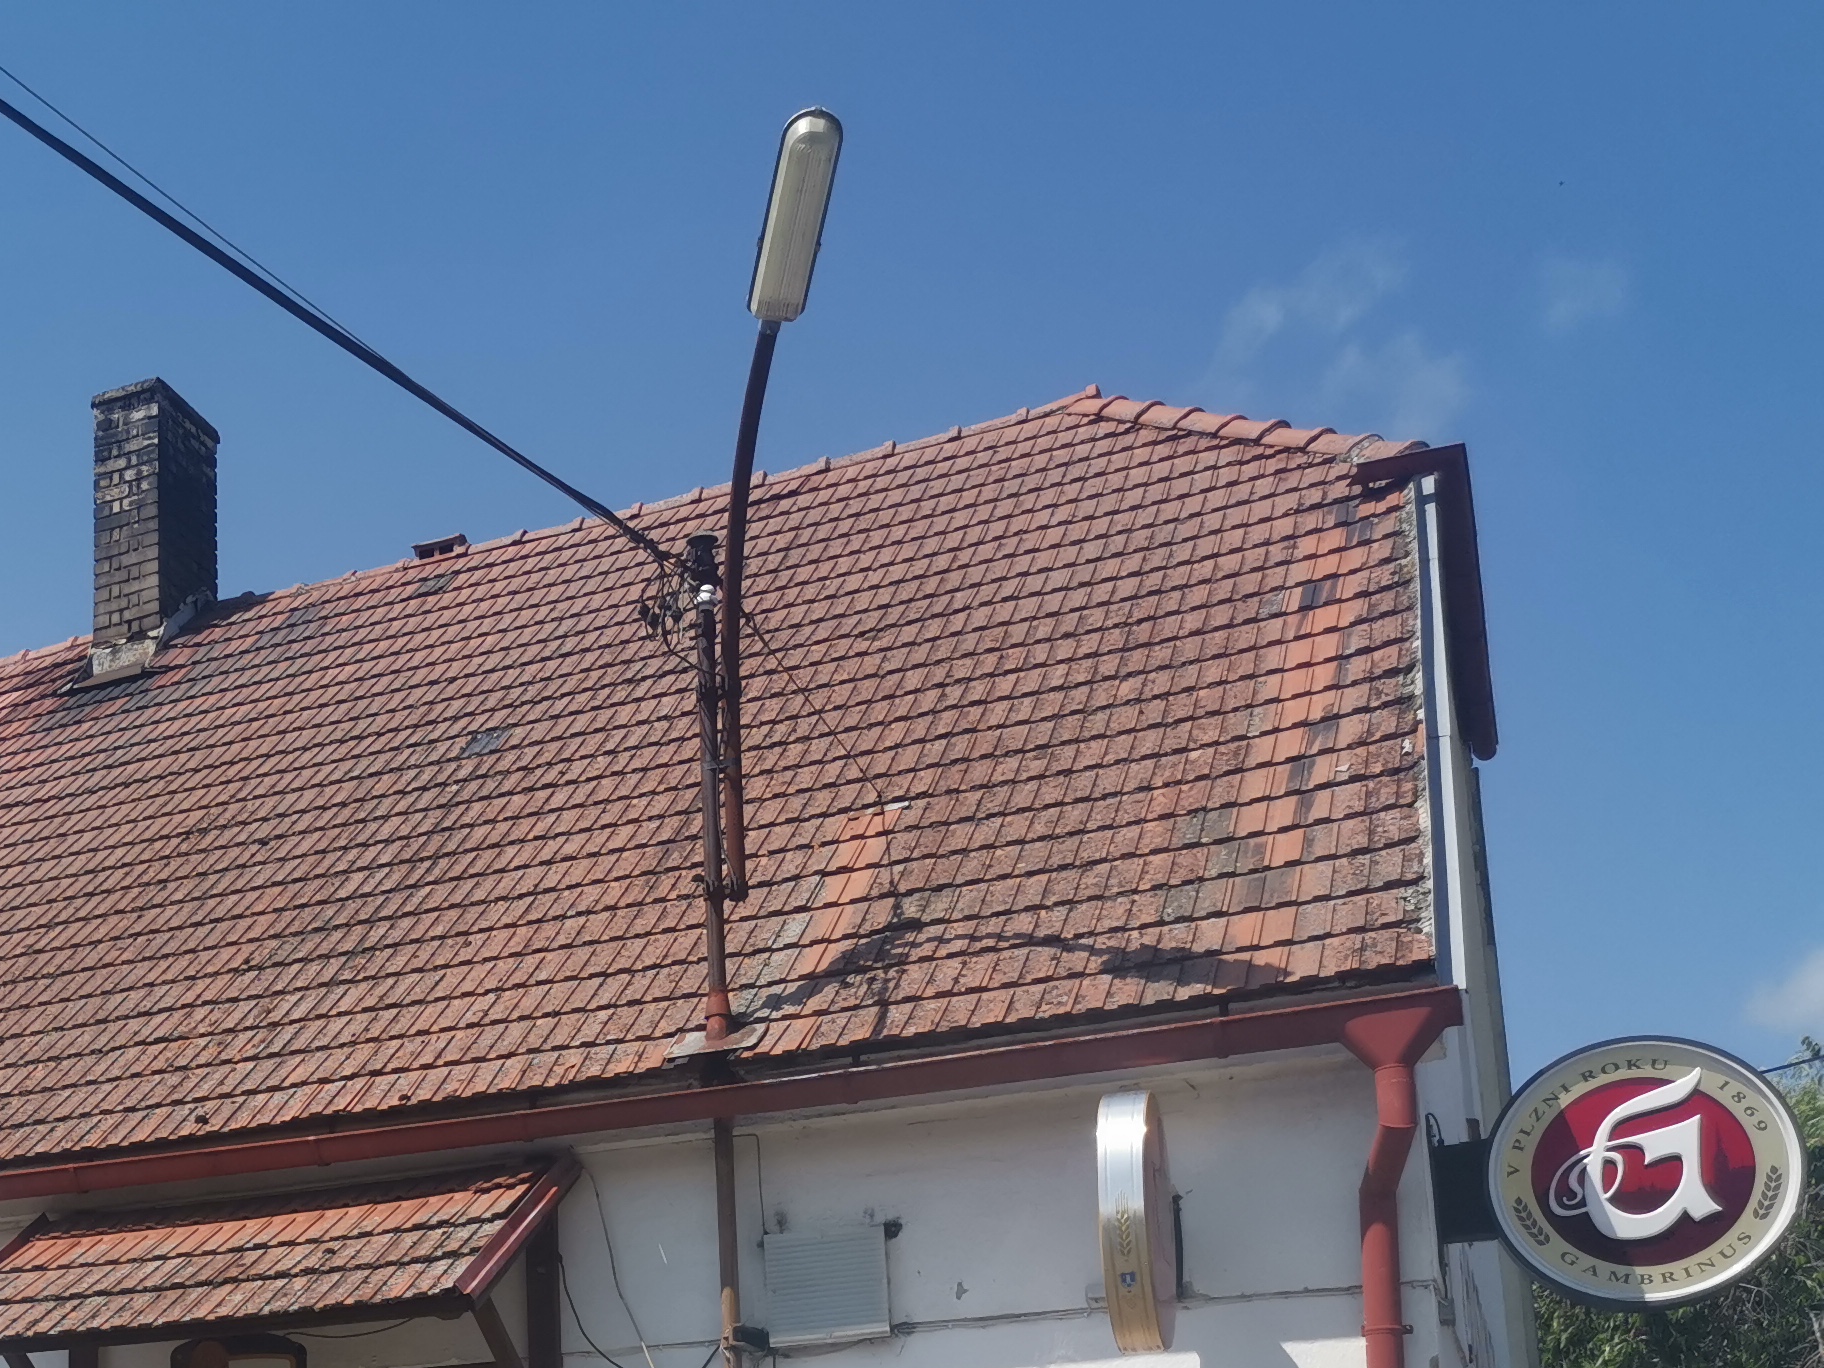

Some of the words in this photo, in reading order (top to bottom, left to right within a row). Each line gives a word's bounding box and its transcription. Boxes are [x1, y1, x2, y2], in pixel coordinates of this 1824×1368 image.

[1579, 1058, 1671, 1084] ROKU
[1511, 1082, 1573, 1153] PLZNI
[1716, 1079, 1769, 1133] 1869
[1506, 1164, 1521, 1179] V
[1559, 1230, 1753, 1286] GAMBRINUS
